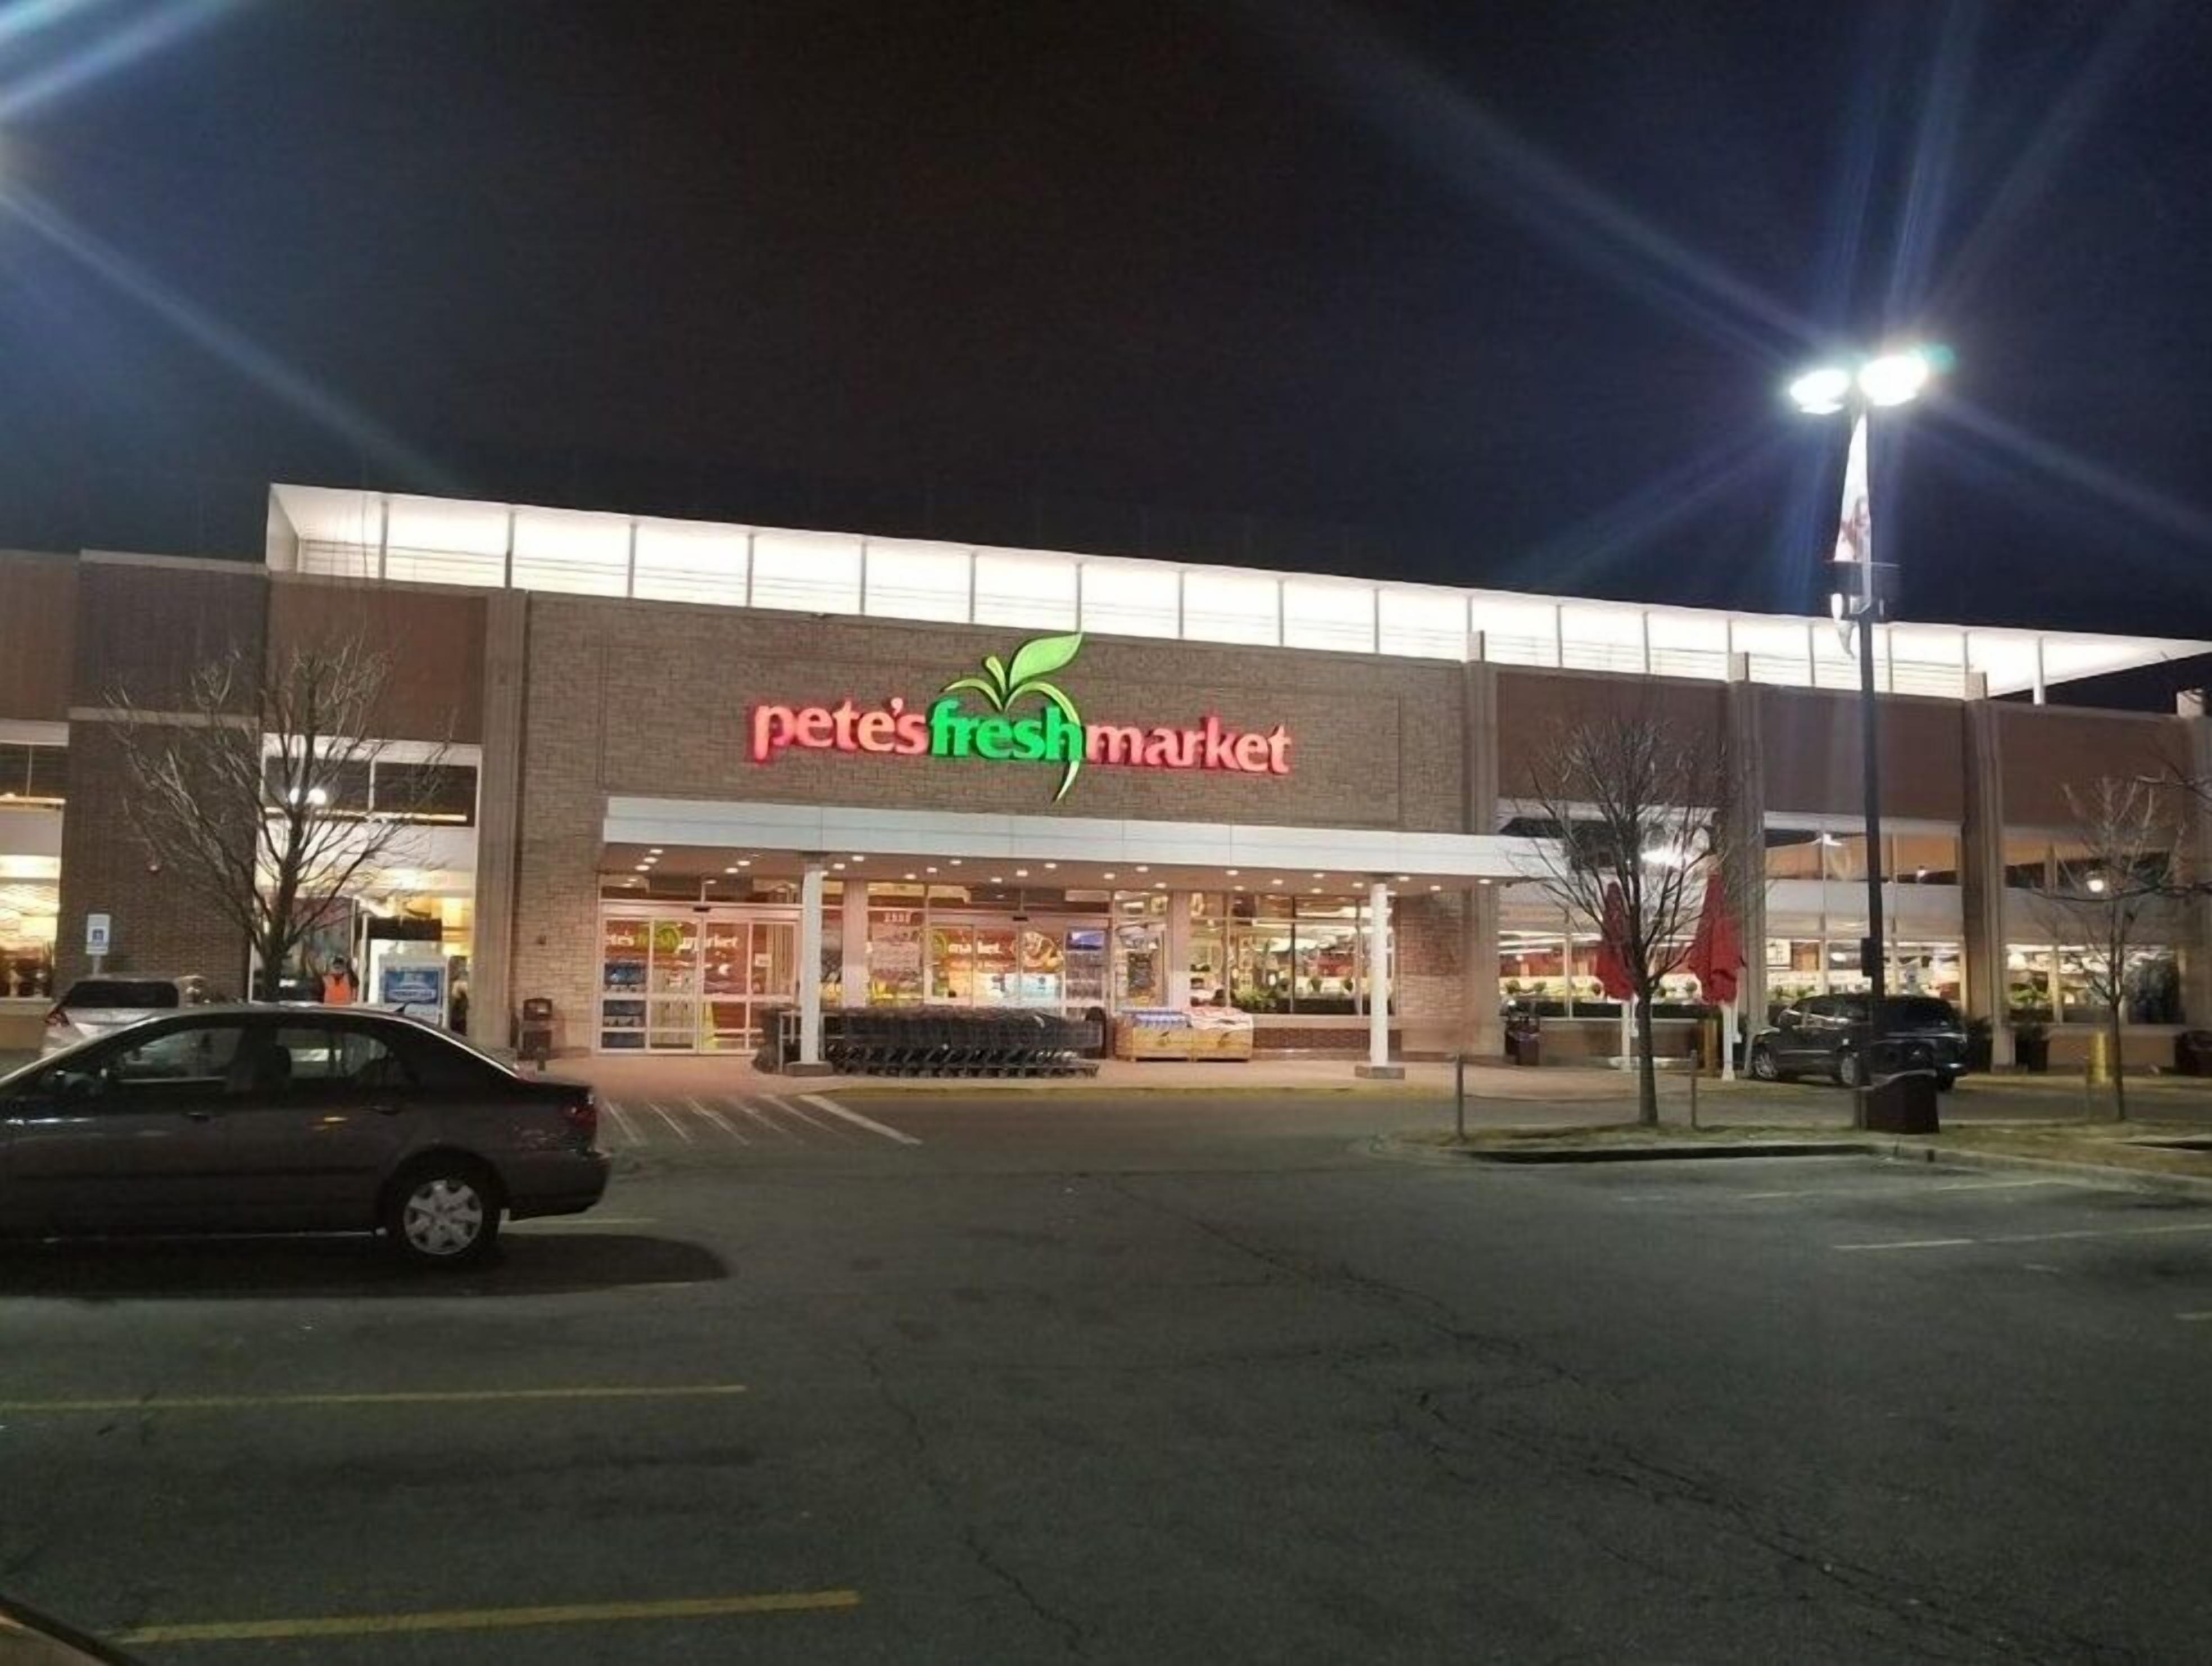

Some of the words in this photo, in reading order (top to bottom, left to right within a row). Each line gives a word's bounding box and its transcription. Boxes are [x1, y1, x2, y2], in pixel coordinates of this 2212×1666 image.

[753, 697, 930, 761] pete's
[930, 698, 1083, 760] fresh
[1085, 715, 1292, 775] market
